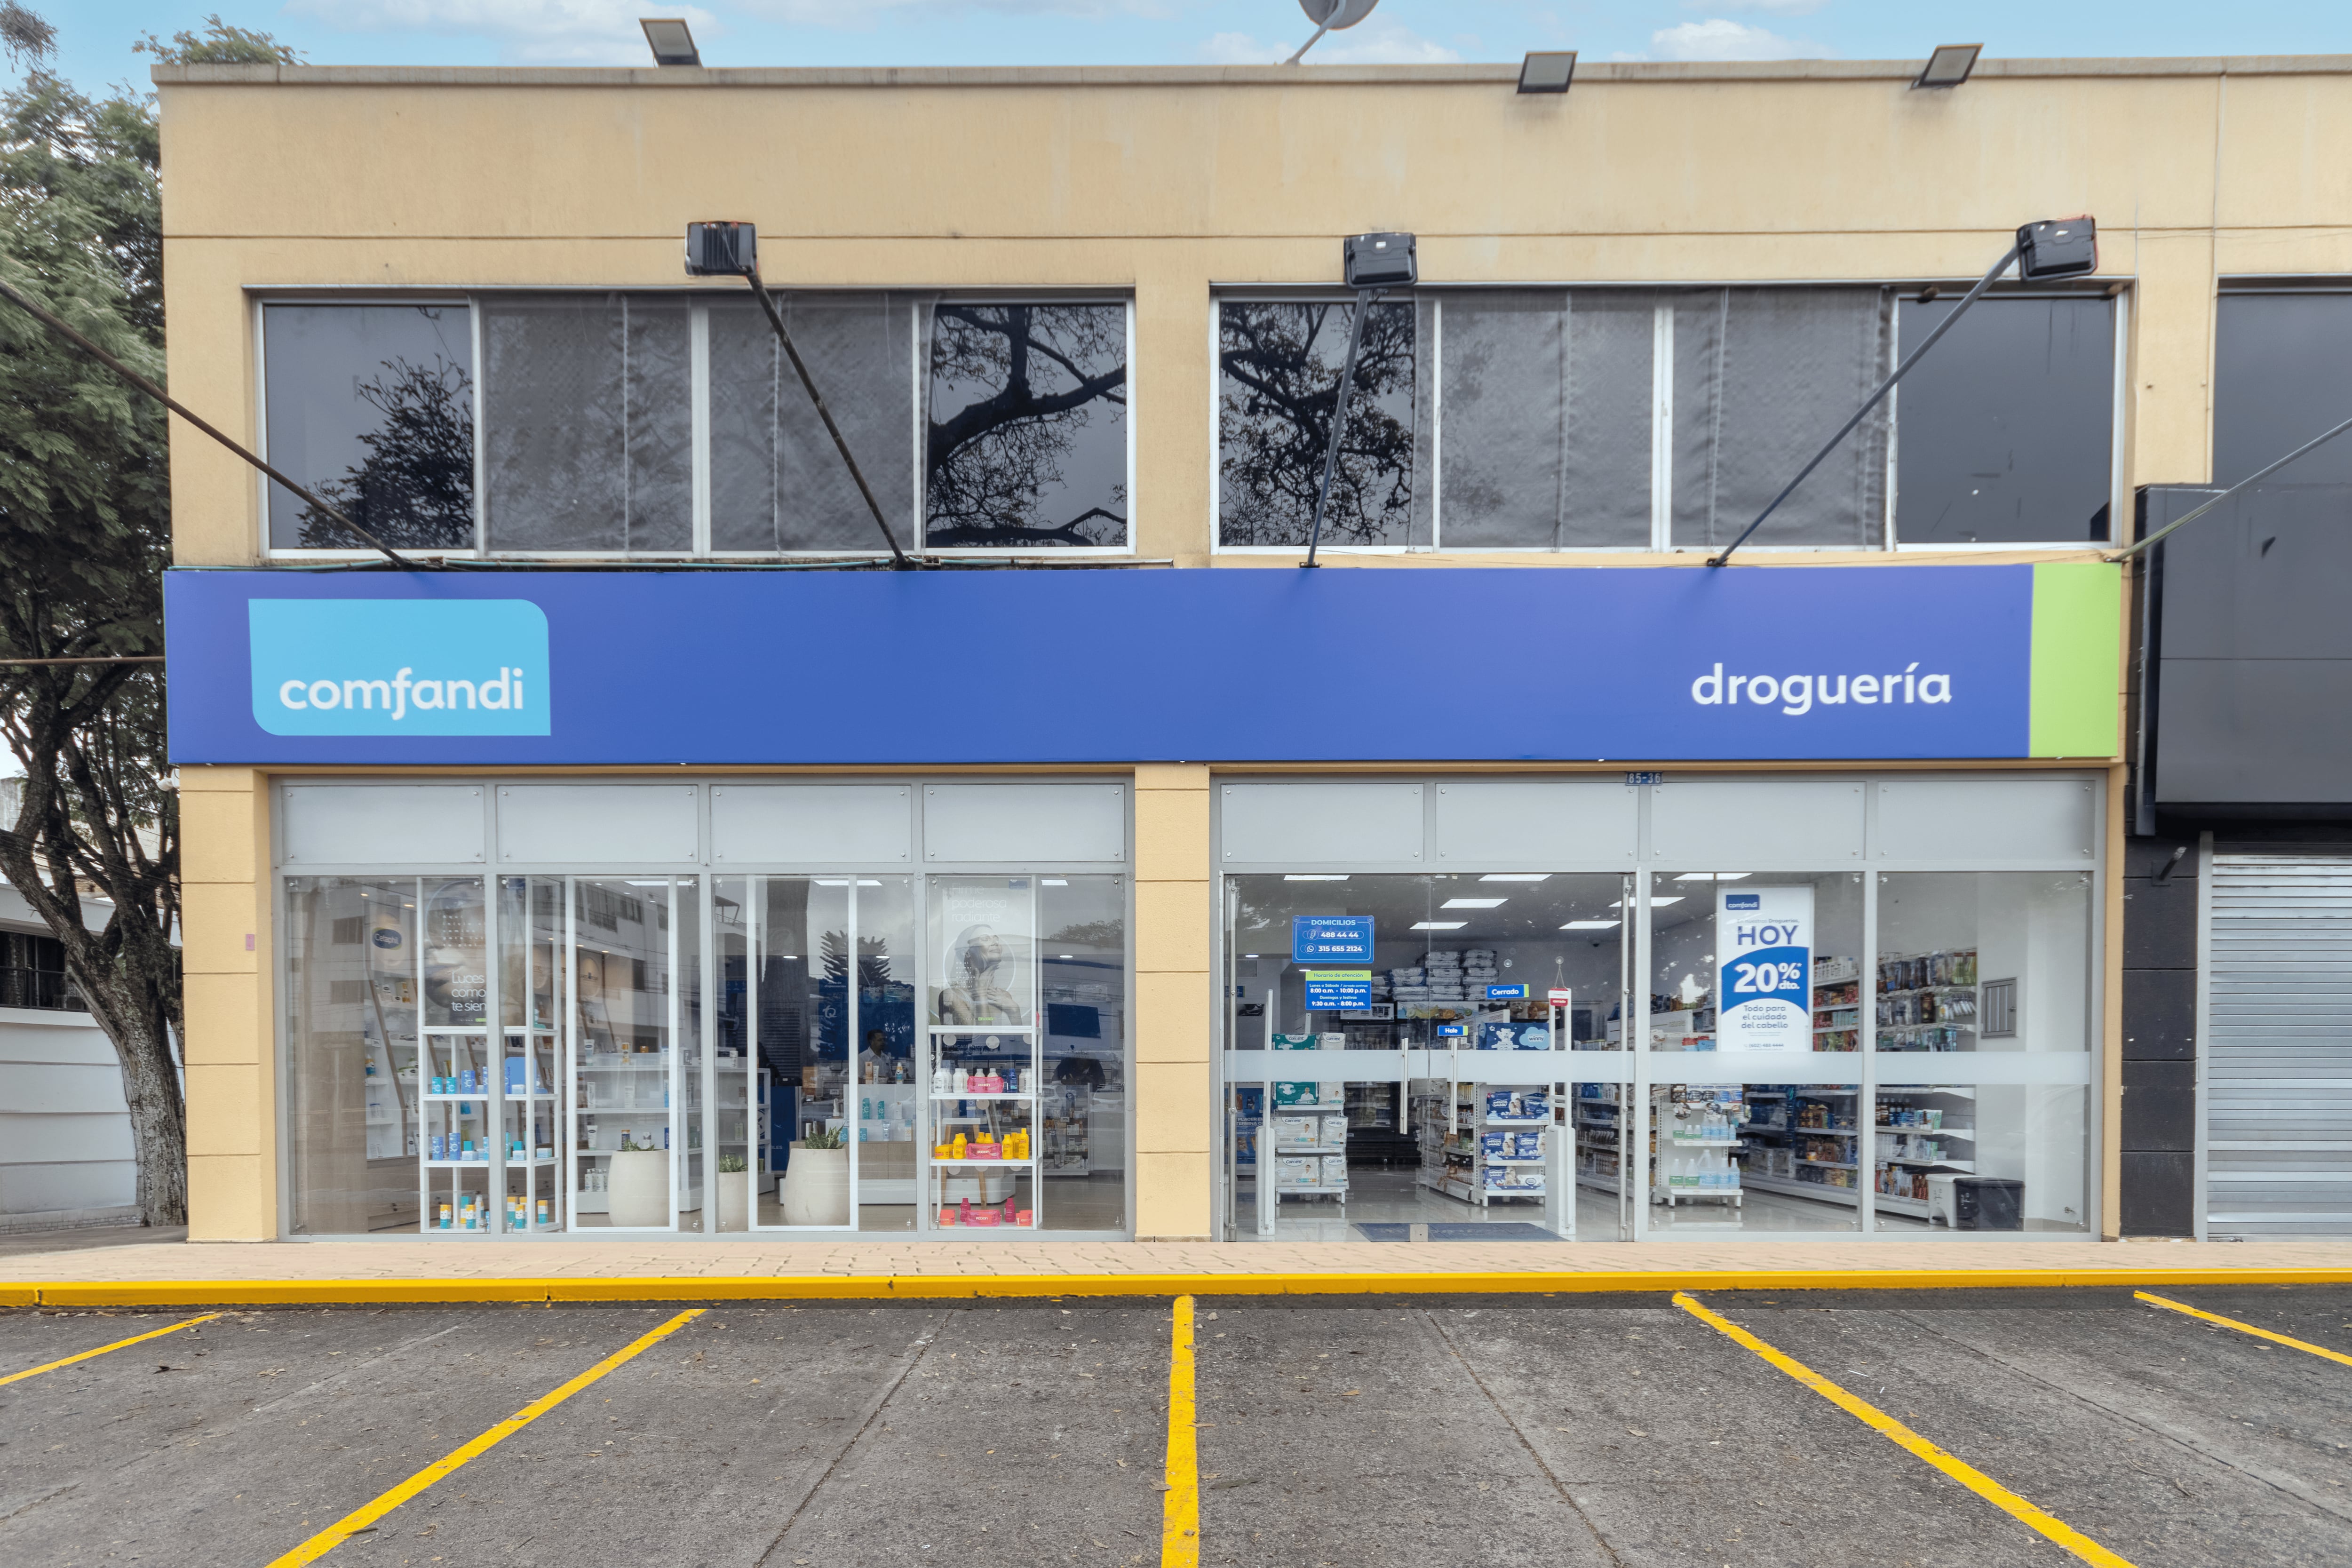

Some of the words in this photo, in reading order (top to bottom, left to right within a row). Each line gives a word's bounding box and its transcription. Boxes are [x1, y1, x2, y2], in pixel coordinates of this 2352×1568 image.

[279, 667, 523, 721] comfandi
[1692, 662, 1952, 716] droguería
[1629, 773, 1661, 783] 85-36
[952, 883, 984, 894] Firme
[952, 898, 1007, 911] poderosa
[952, 911, 1001, 922] radiante
[1738, 925, 1799, 945] HOY
[452, 972, 485, 984] Luces
[1778, 980, 1800, 989] dto.
[451, 988, 486, 997] como
[451, 1001, 463, 1011] te
